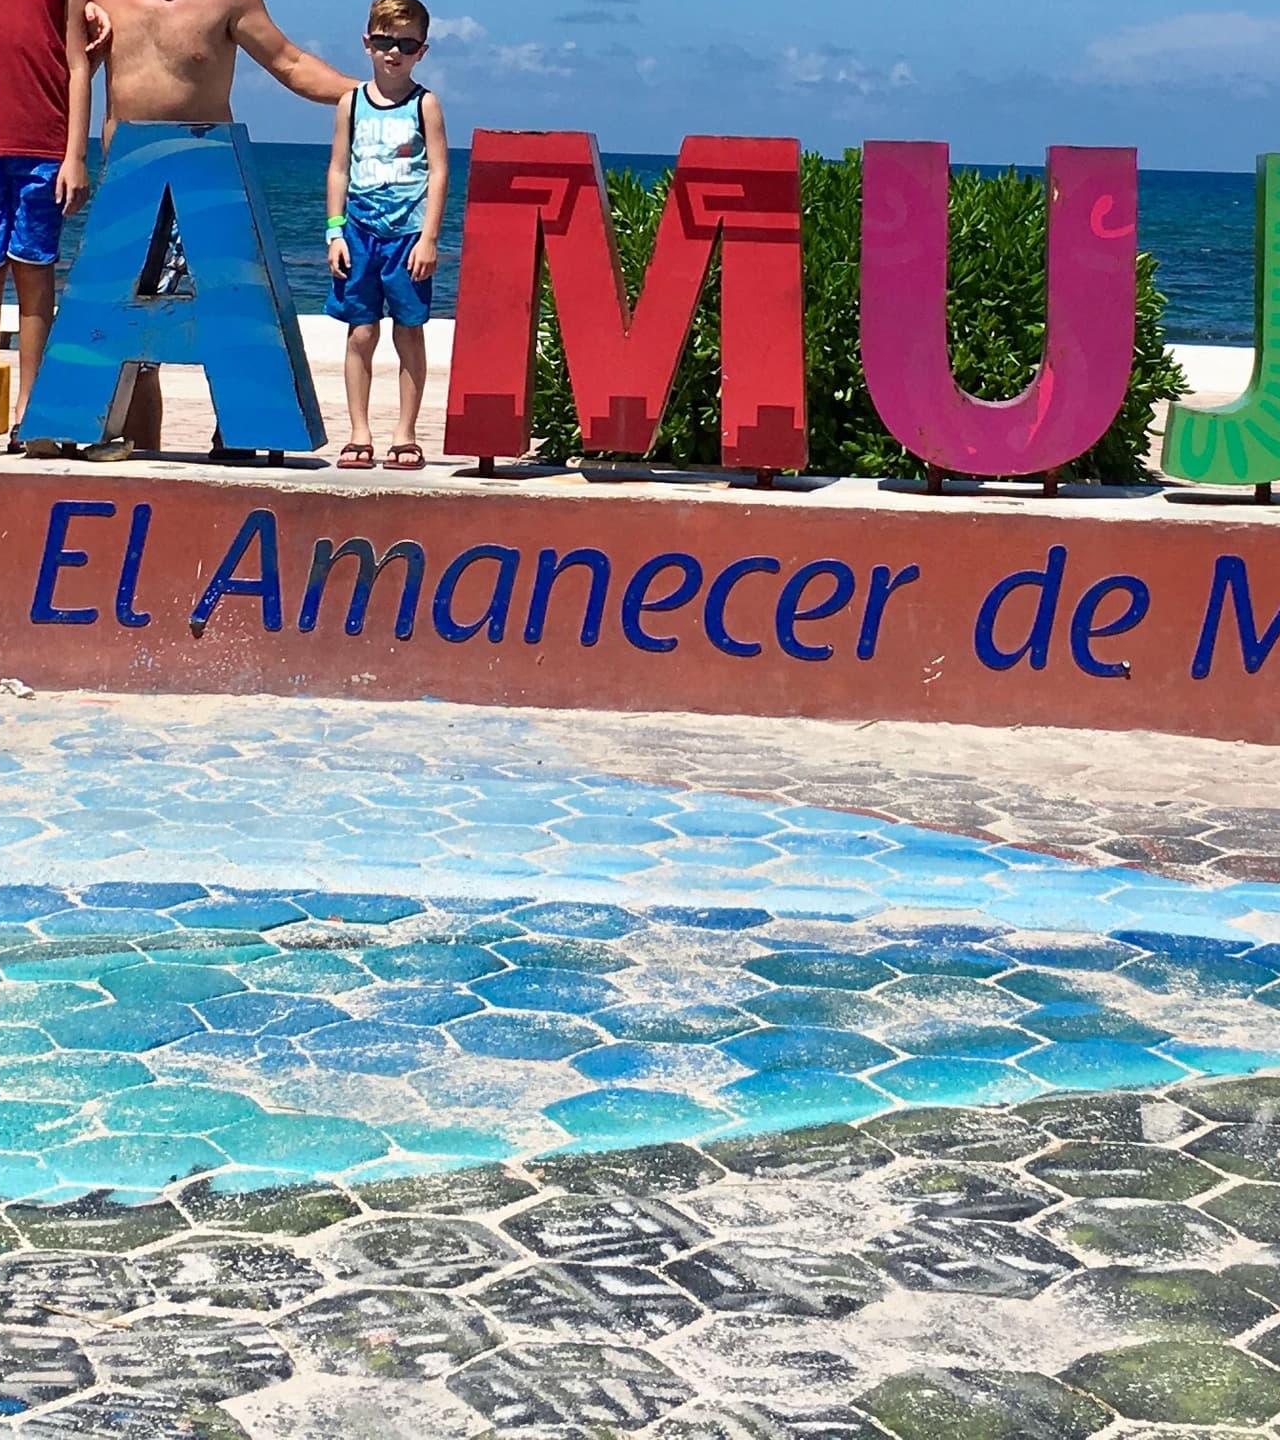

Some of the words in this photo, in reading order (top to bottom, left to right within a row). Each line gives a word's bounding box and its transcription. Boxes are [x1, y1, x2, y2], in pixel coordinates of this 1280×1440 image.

[29, 499, 152, 629] El
[188, 506, 920, 662] Amanecer
[973, 544, 1152, 678] de
